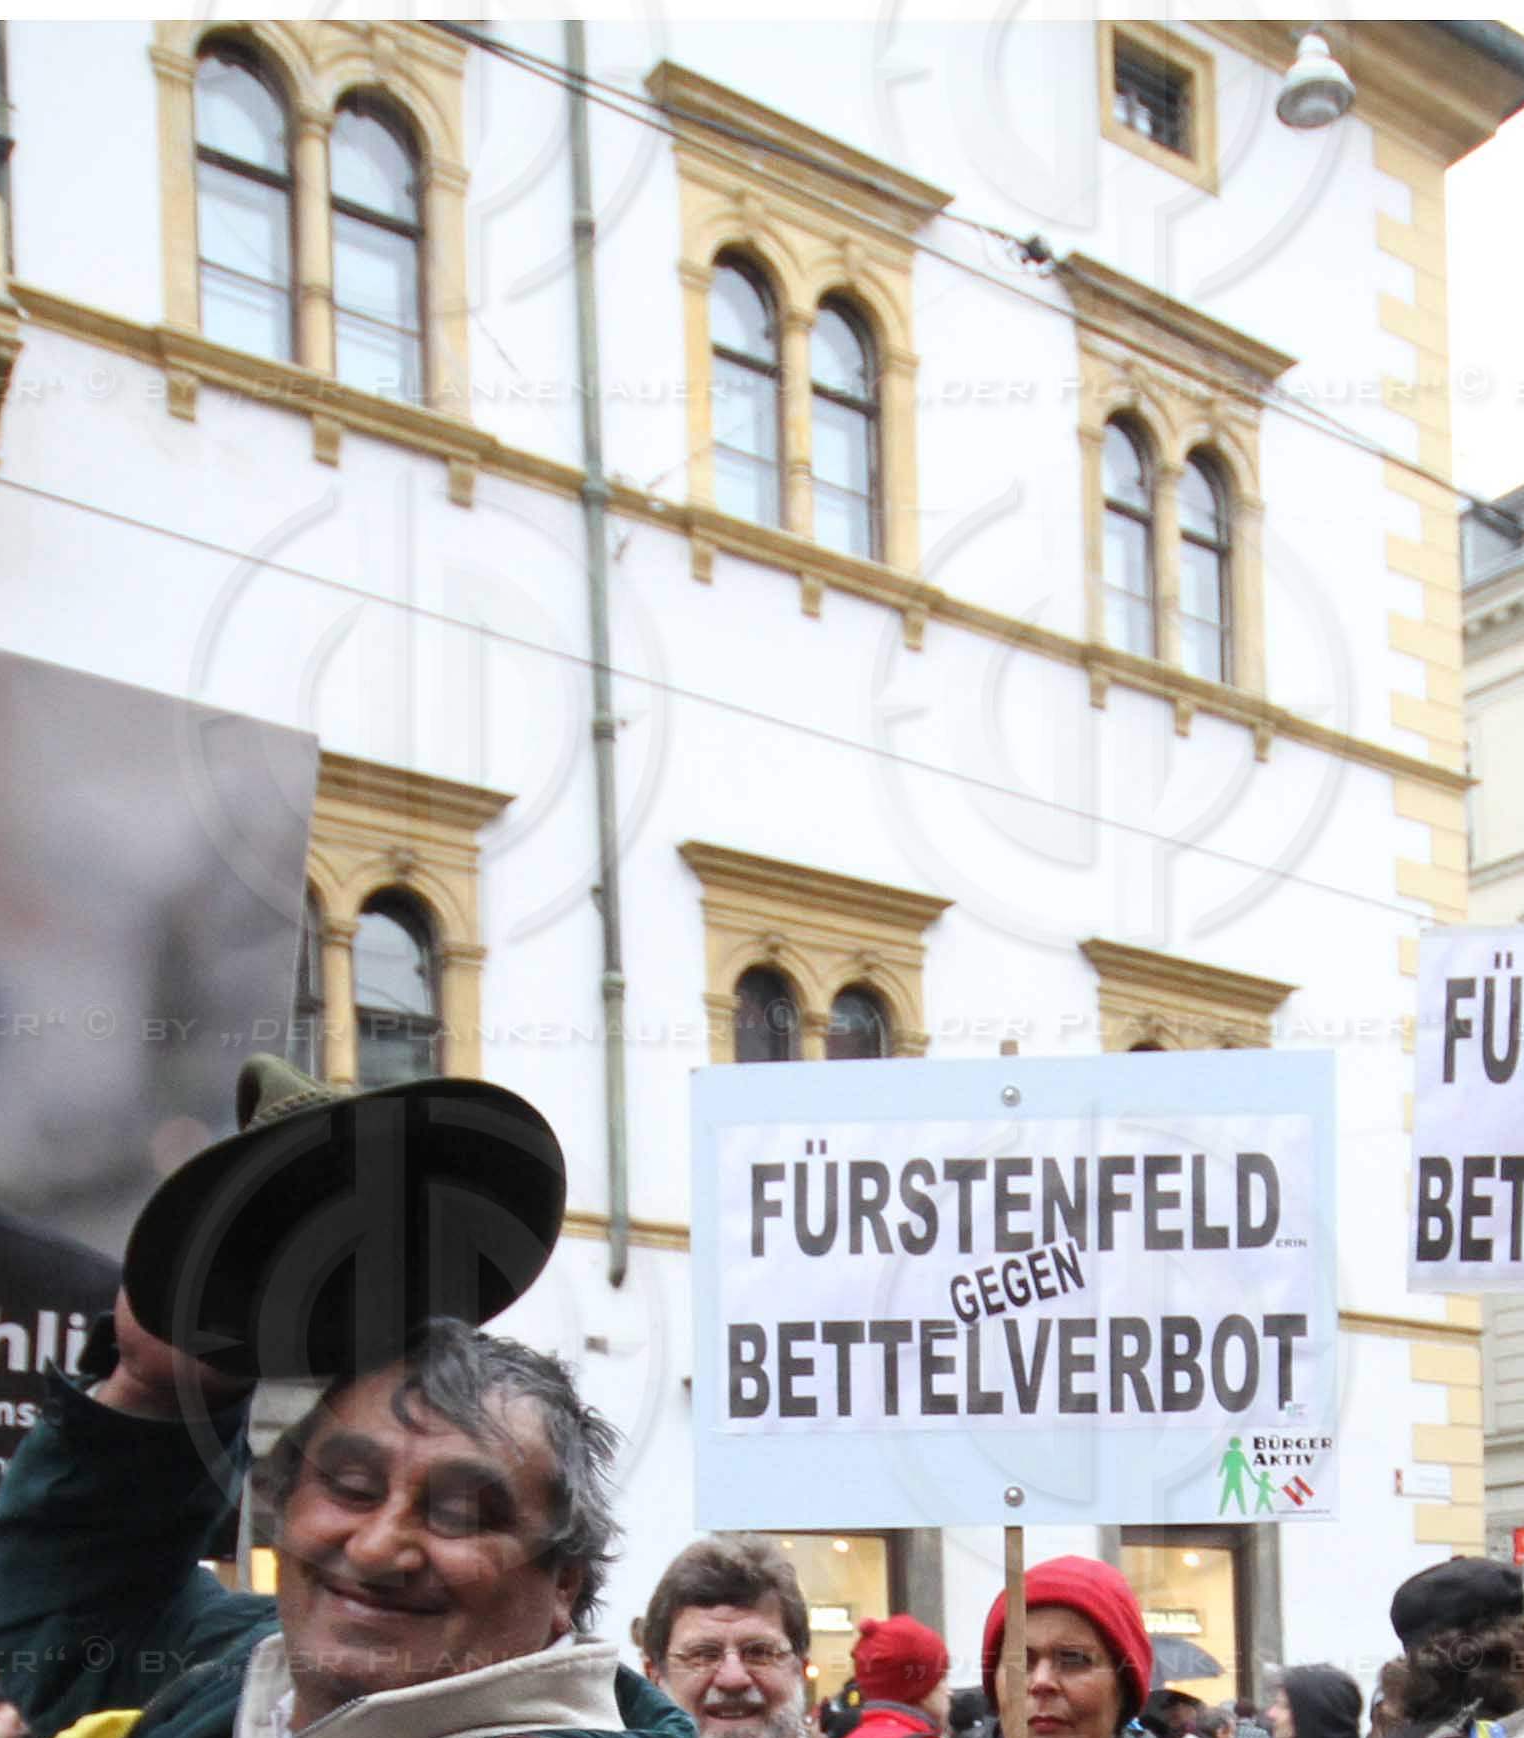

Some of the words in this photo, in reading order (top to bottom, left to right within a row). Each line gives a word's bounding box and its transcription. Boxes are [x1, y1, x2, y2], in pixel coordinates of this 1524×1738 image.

[748, 1140, 1280, 1258] FÜRSTENFELD
[949, 1241, 1085, 1325] GEGEN
[727, 1312, 1307, 1419] BETTELVERBOT
[1252, 1435, 1334, 1451] BÜRGER
[1252, 1452, 1315, 1467] AKTIV
